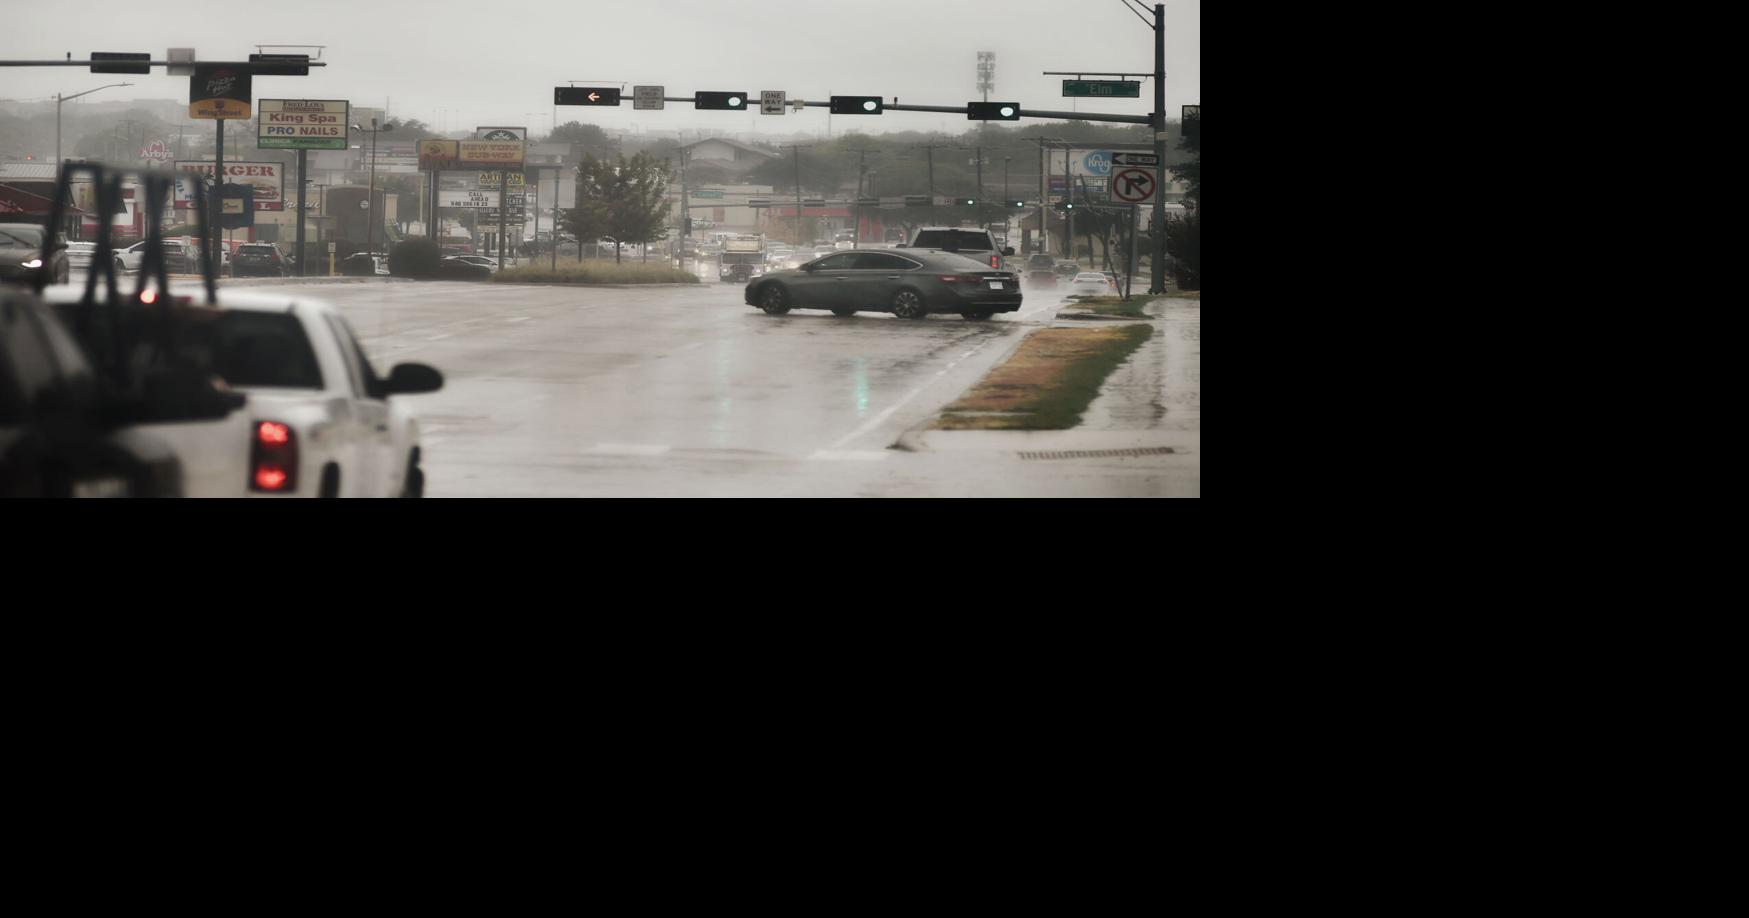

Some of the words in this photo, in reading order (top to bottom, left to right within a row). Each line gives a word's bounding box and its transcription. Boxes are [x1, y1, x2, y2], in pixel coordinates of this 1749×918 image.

[1090, 83, 1112, 94] Elm
[269, 113, 303, 123] King
[308, 113, 337, 124] Spa
[267, 126, 295, 135] PRO
[300, 127, 338, 136] NAILS
[1088, 154, 1111, 173] Krog
[182, 165, 275, 177] BURGER
